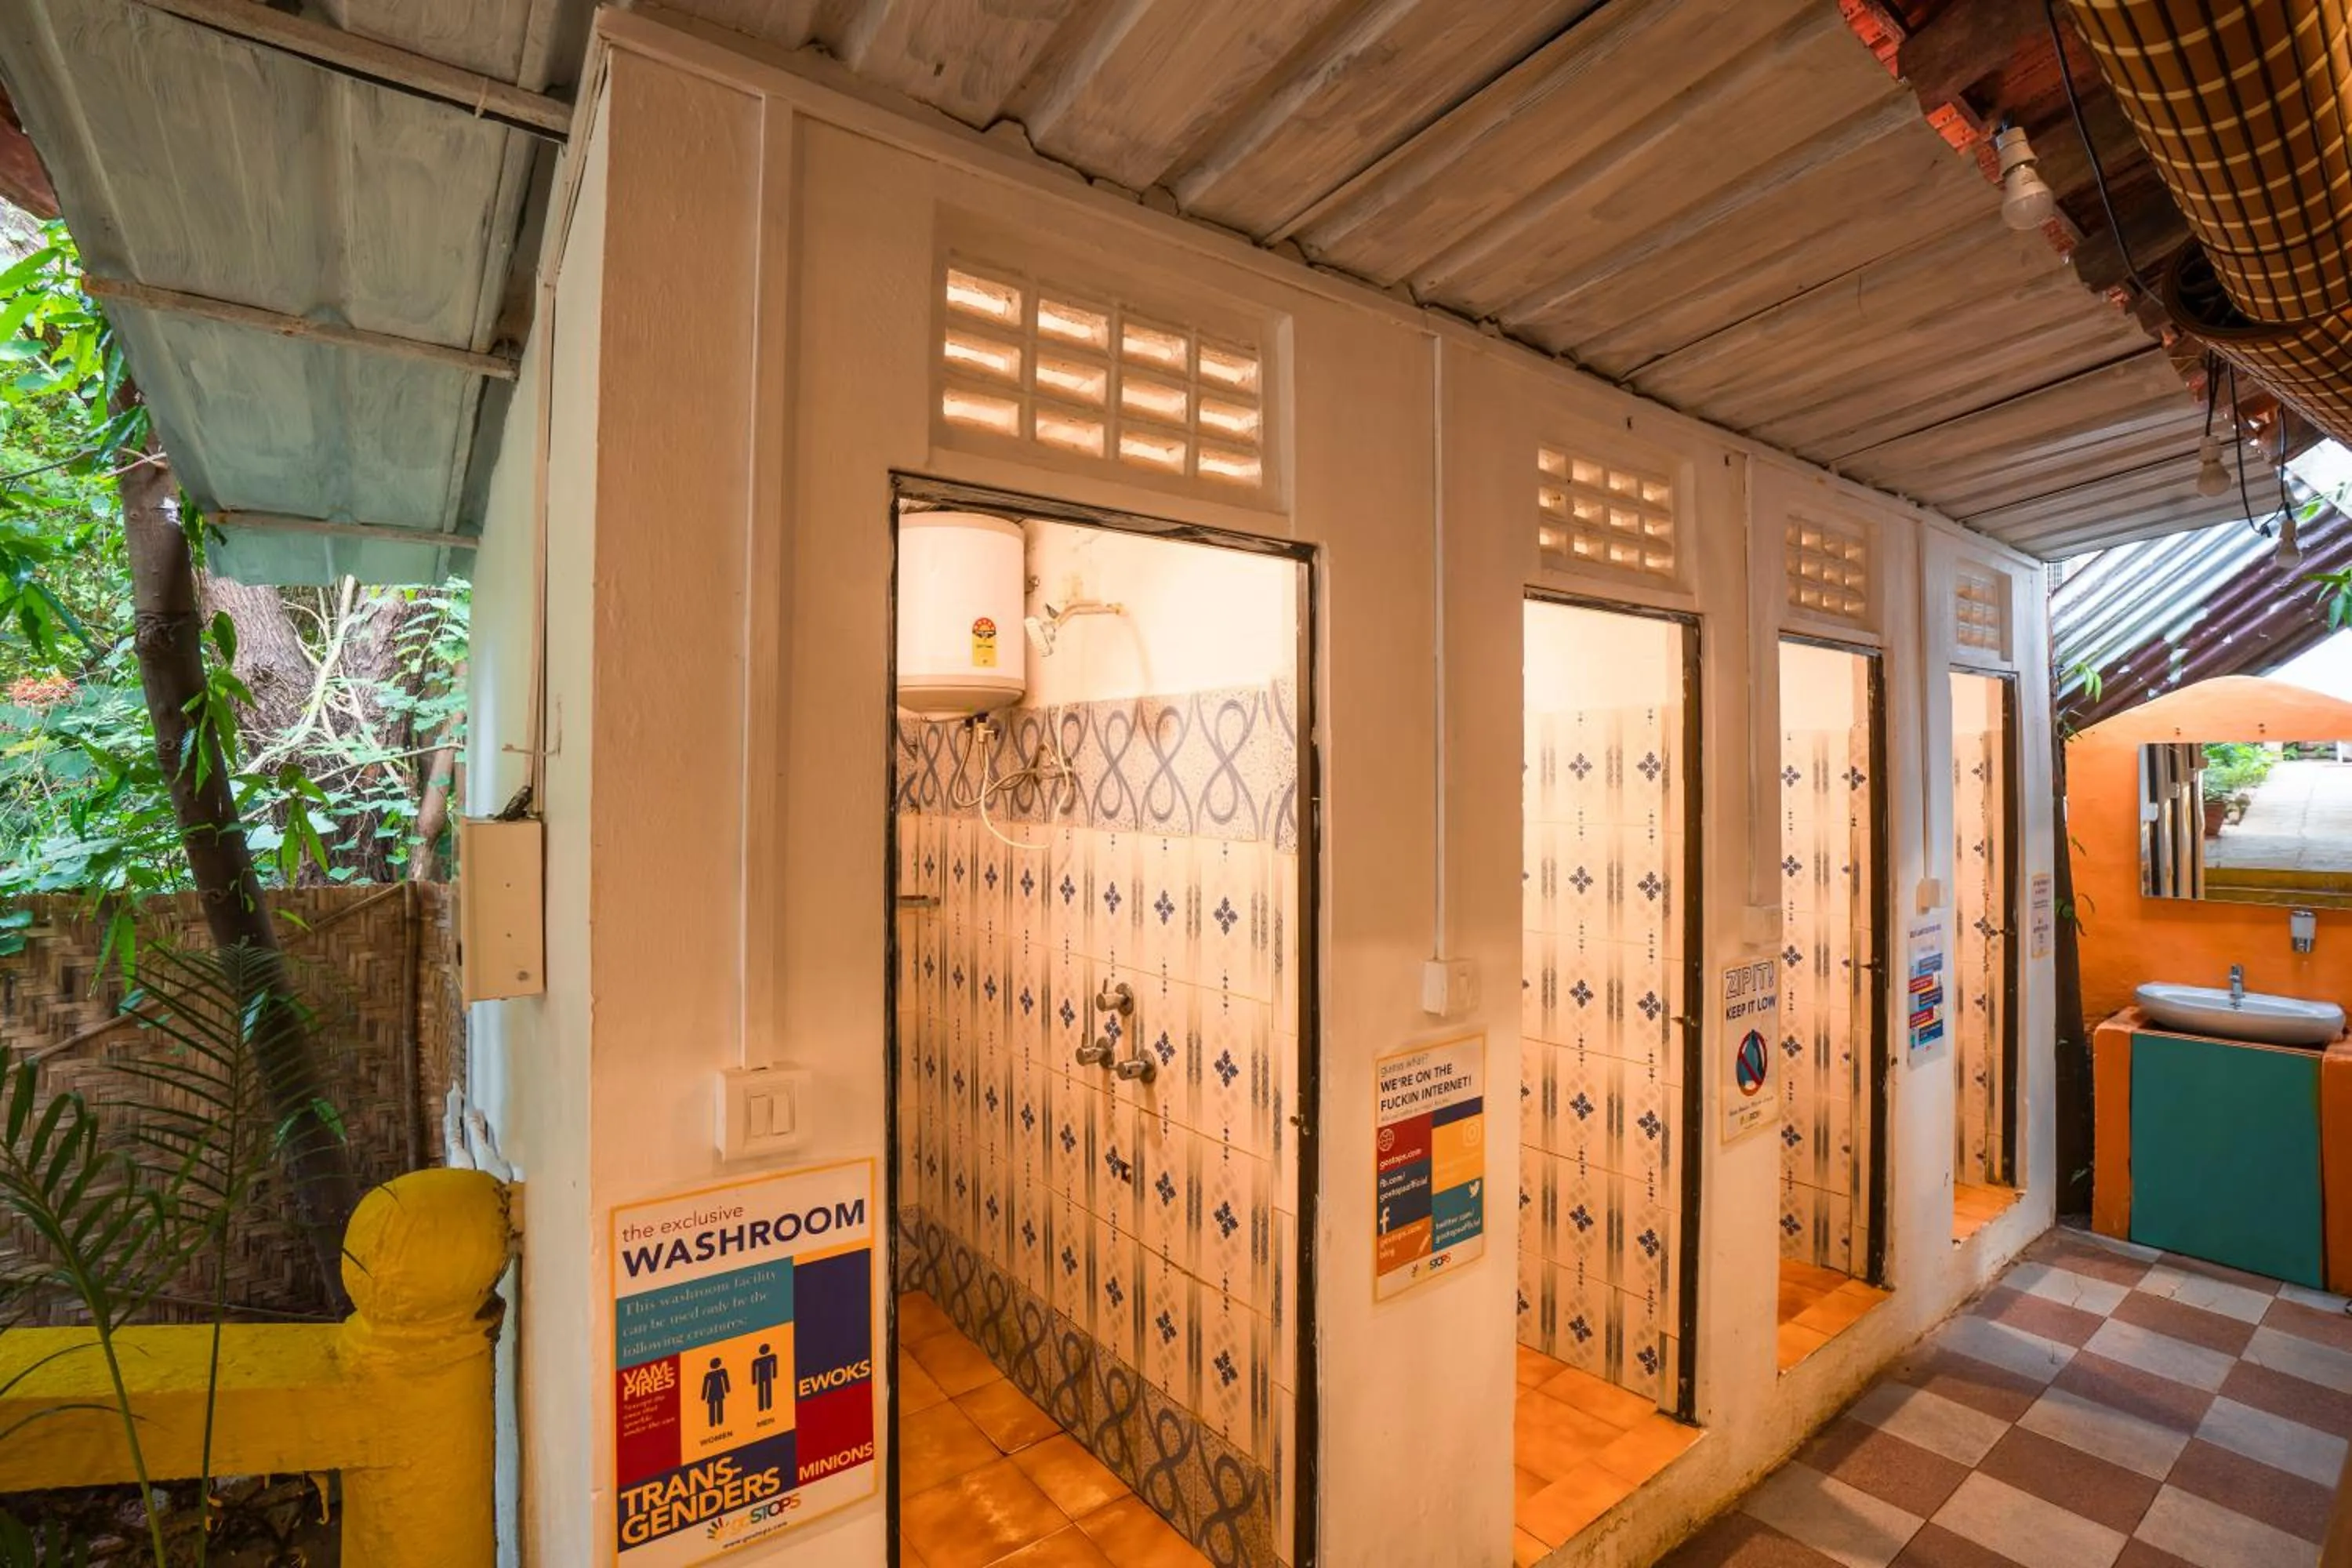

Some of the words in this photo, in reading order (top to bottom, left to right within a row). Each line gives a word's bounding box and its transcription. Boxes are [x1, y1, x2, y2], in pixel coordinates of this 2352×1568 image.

[1726, 1003, 1746, 1022] KEEP
[1748, 1000, 1755, 1015] IT
[1757, 994, 1777, 1012] LOW
[1380, 1073, 1414, 1094] WE'RE
[1415, 1069, 1432, 1083] ON
[1433, 1062, 1453, 1079] THE
[1380, 1090, 1419, 1112] FUCKIN
[1421, 1074, 1472, 1100] INTERNET!
[622, 1224, 655, 1243] the
[660, 1204, 744, 1235] exclusive
[622, 1198, 865, 1278] WASHROOM
[625, 1299, 655, 1317] This
[659, 1281, 730, 1307] washroom
[733, 1269, 777, 1290] facility
[650, 1314, 666, 1330] be
[670, 1307, 699, 1326] used
[701, 1299, 730, 1318] only
[732, 1293, 747, 1308] by
[750, 1290, 768, 1305] the
[622, 1334, 685, 1359] following
[621, 1360, 675, 1385] VAM-
[623, 1377, 676, 1402] PIRES
[798, 1359, 870, 1397] EWOKS
[699, 1429, 734, 1447] WOMEN
[756, 1417, 776, 1428] MEN
[798, 1442, 873, 1482] MINIONS
[620, 1455, 742, 1517] TRANS-
[622, 1466, 781, 1544] GENDERS
